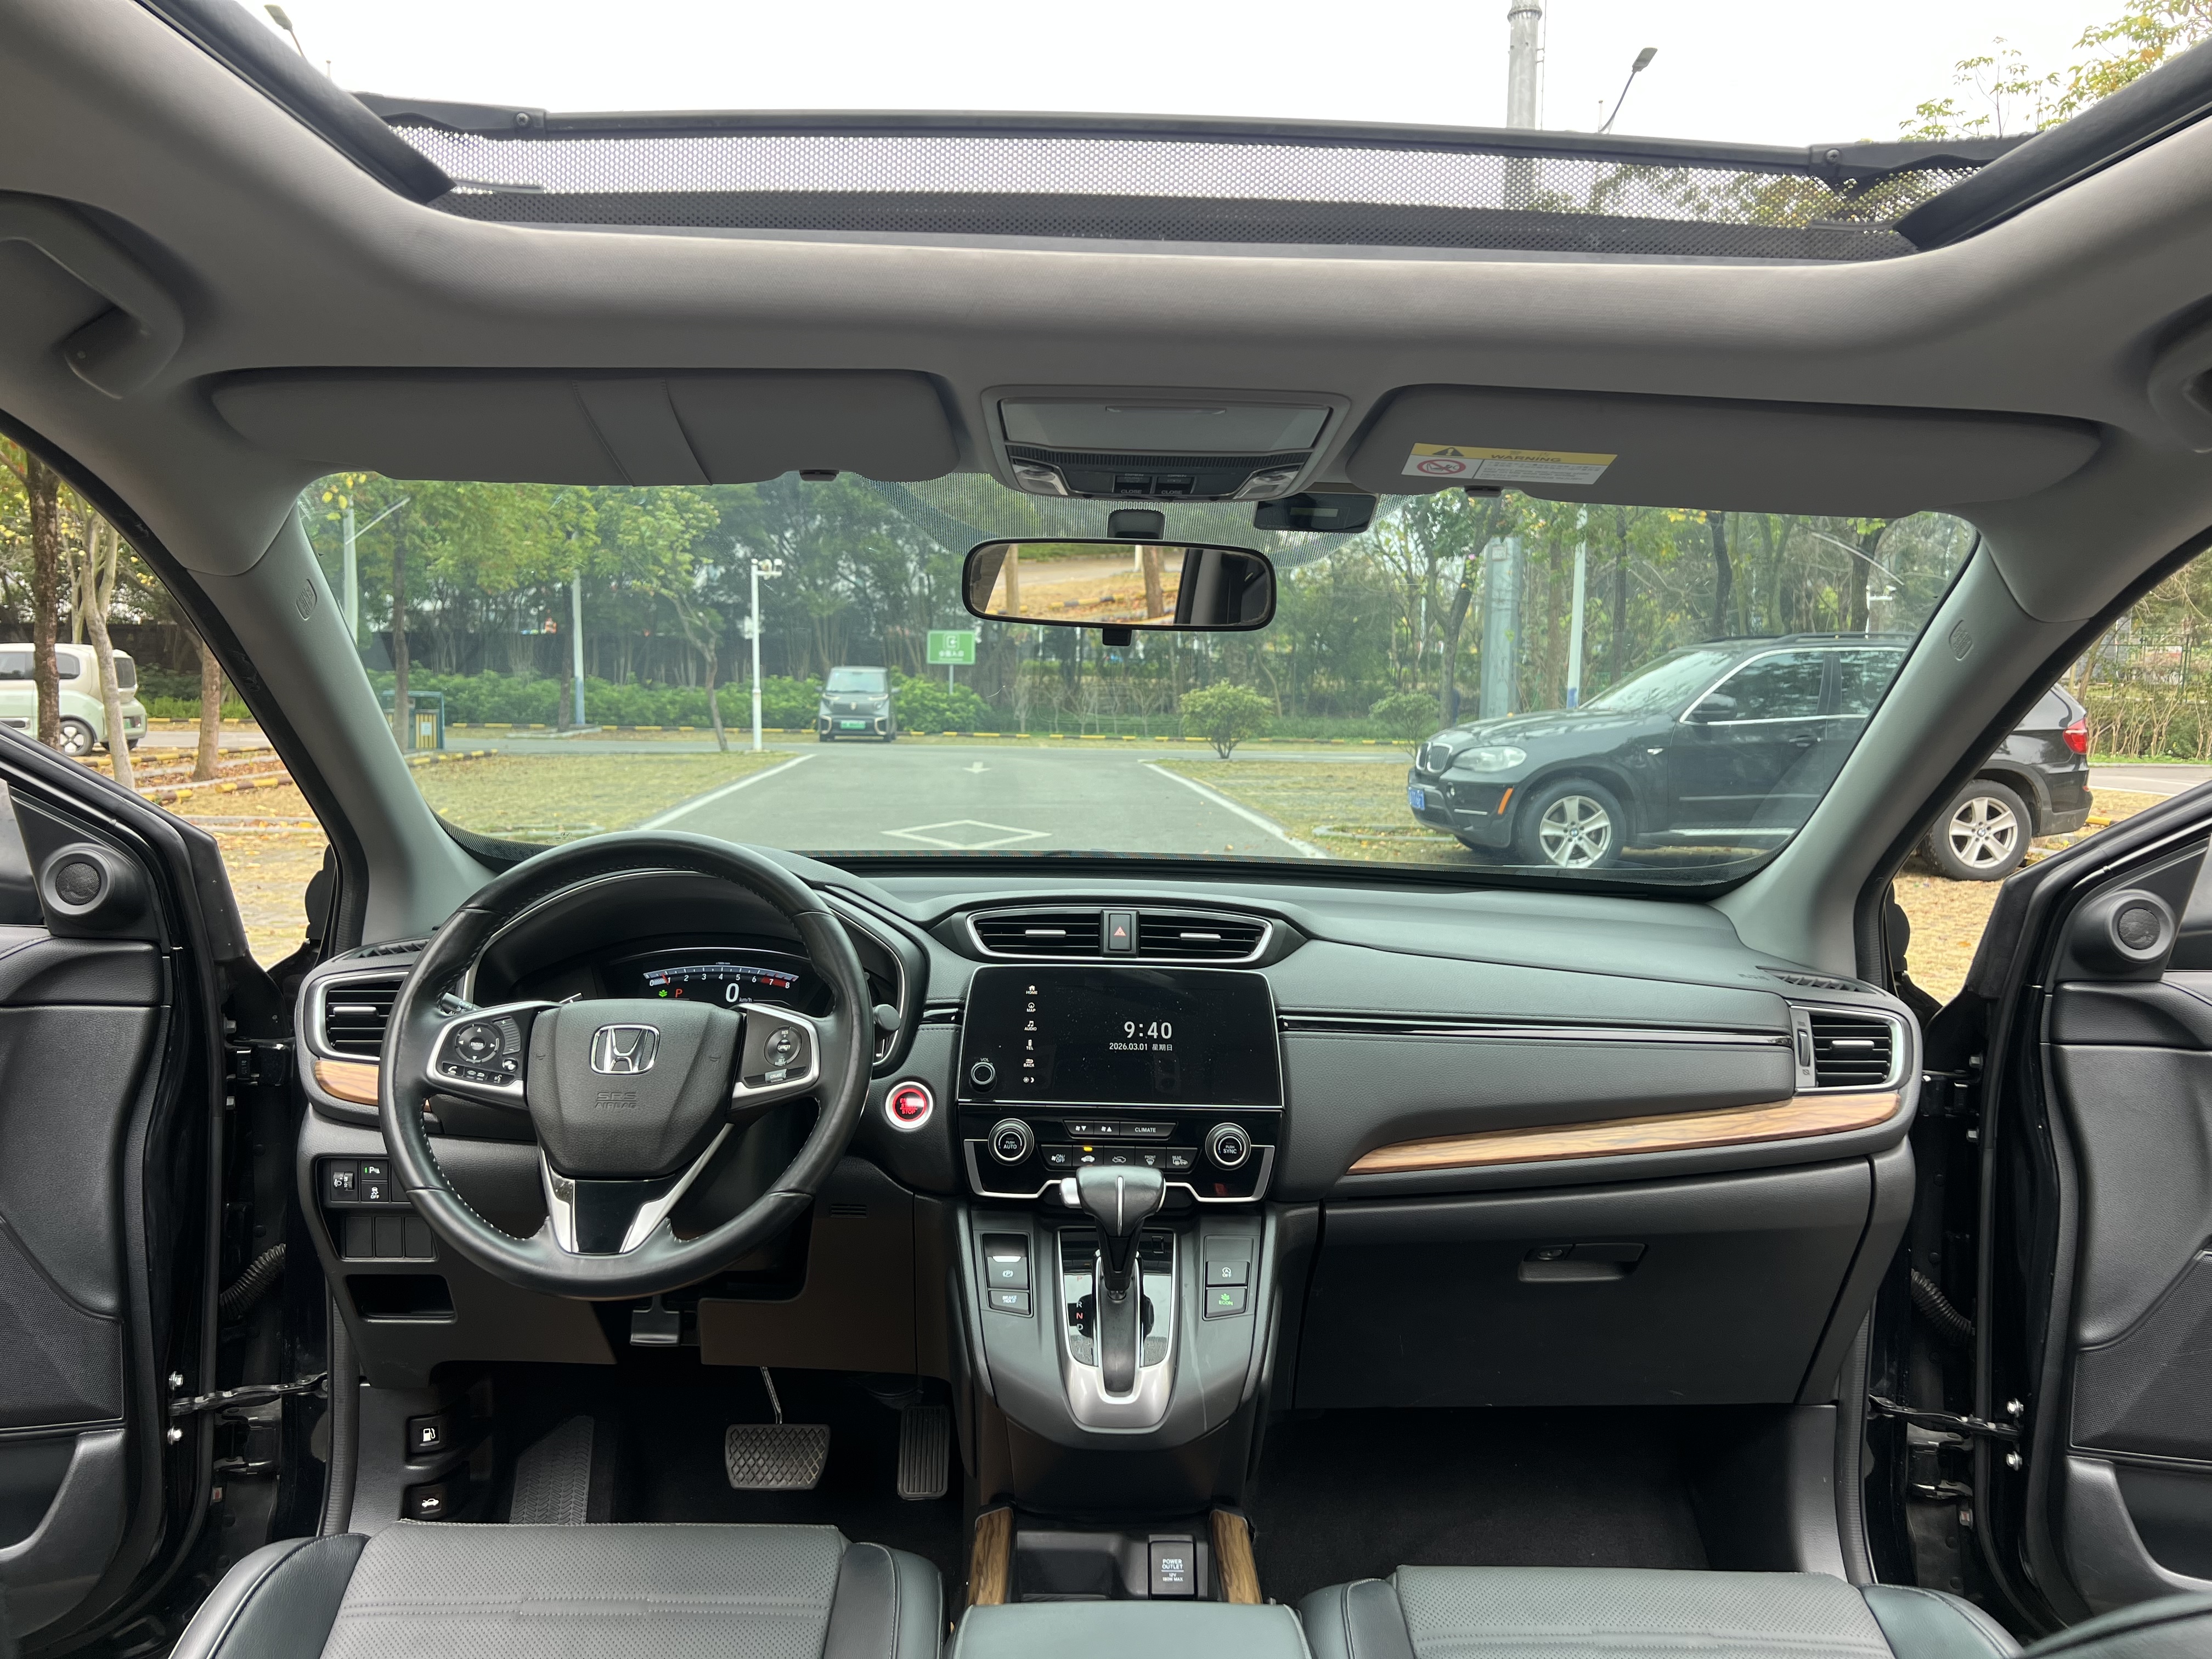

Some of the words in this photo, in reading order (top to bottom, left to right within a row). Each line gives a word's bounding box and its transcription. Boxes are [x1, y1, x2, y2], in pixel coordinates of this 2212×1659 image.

[675, 989, 682, 998] P
[725, 983, 740, 1003] 0
[1124, 1021, 1172, 1039] 9:40
[1109, 1042, 1148, 1051] 2026.03.01
[597, 1092, 637, 1101] SRS
